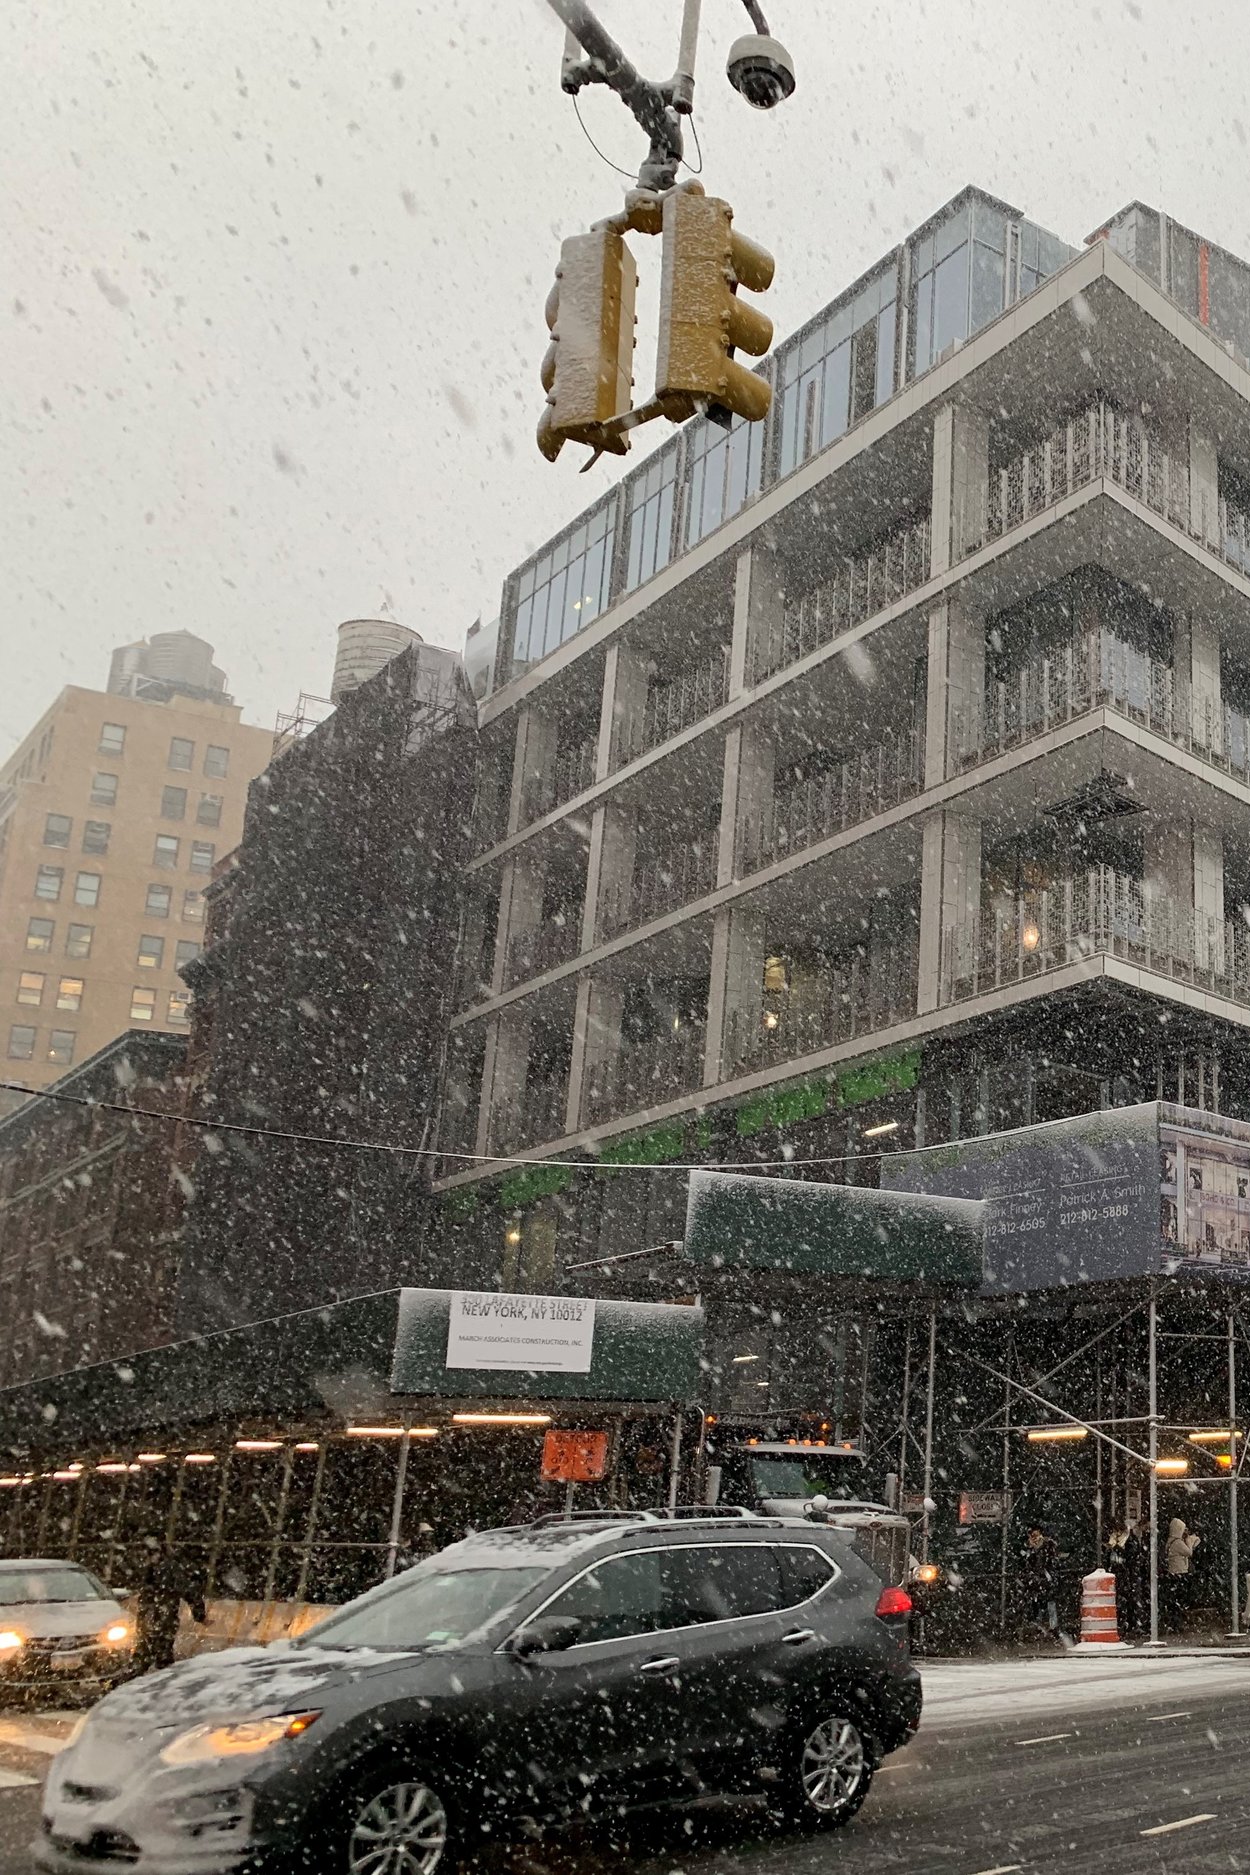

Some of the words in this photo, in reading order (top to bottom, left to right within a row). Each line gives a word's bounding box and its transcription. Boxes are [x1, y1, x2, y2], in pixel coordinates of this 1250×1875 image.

[1060, 1193, 1096, 1207] Patrick
[1114, 1185, 1146, 1199] Smith
[1060, 1205, 1129, 1225] 212-812-5888
[986, 1217, 1046, 1237] 12-812-6505
[462, 1305, 489, 1317] NEW
[494, 1306, 528, 1320] YORK,
[531, 1308, 546, 1320] NY
[550, 1310, 583, 1322] 10012
[459, 1335, 483, 1343] MARCH
[483, 1336, 520, 1344] ASSOCIATES
